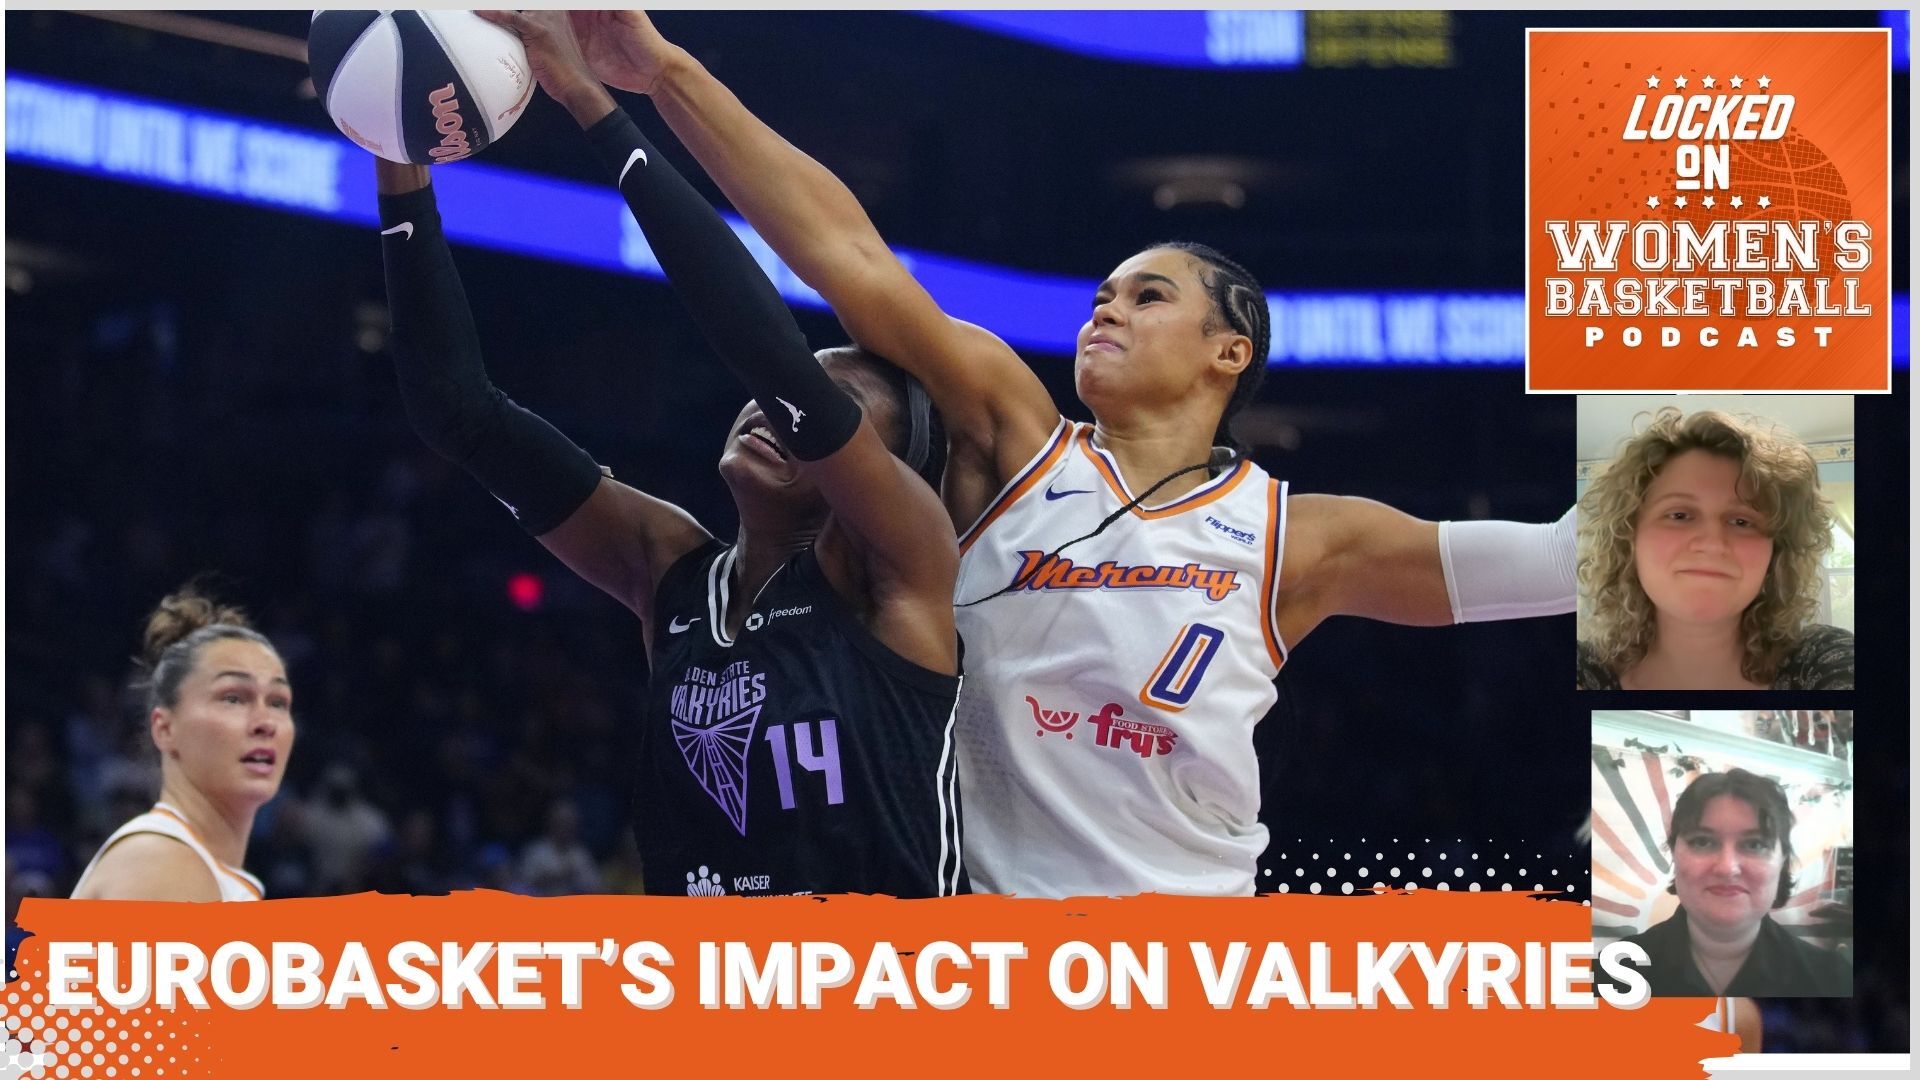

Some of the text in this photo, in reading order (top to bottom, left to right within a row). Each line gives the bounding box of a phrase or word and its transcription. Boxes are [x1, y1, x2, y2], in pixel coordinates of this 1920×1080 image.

[428, 82, 472, 165] ilson
[1004, 550, 1241, 602] Mercury
[767, 605, 812, 625] freedom
[720, 660, 750, 685] STATE
[671, 673, 766, 725] VALKYRIES
[1112, 719, 1138, 730] FOOD
[764, 719, 844, 809] 14
[734, 875, 770, 891] KAISER
